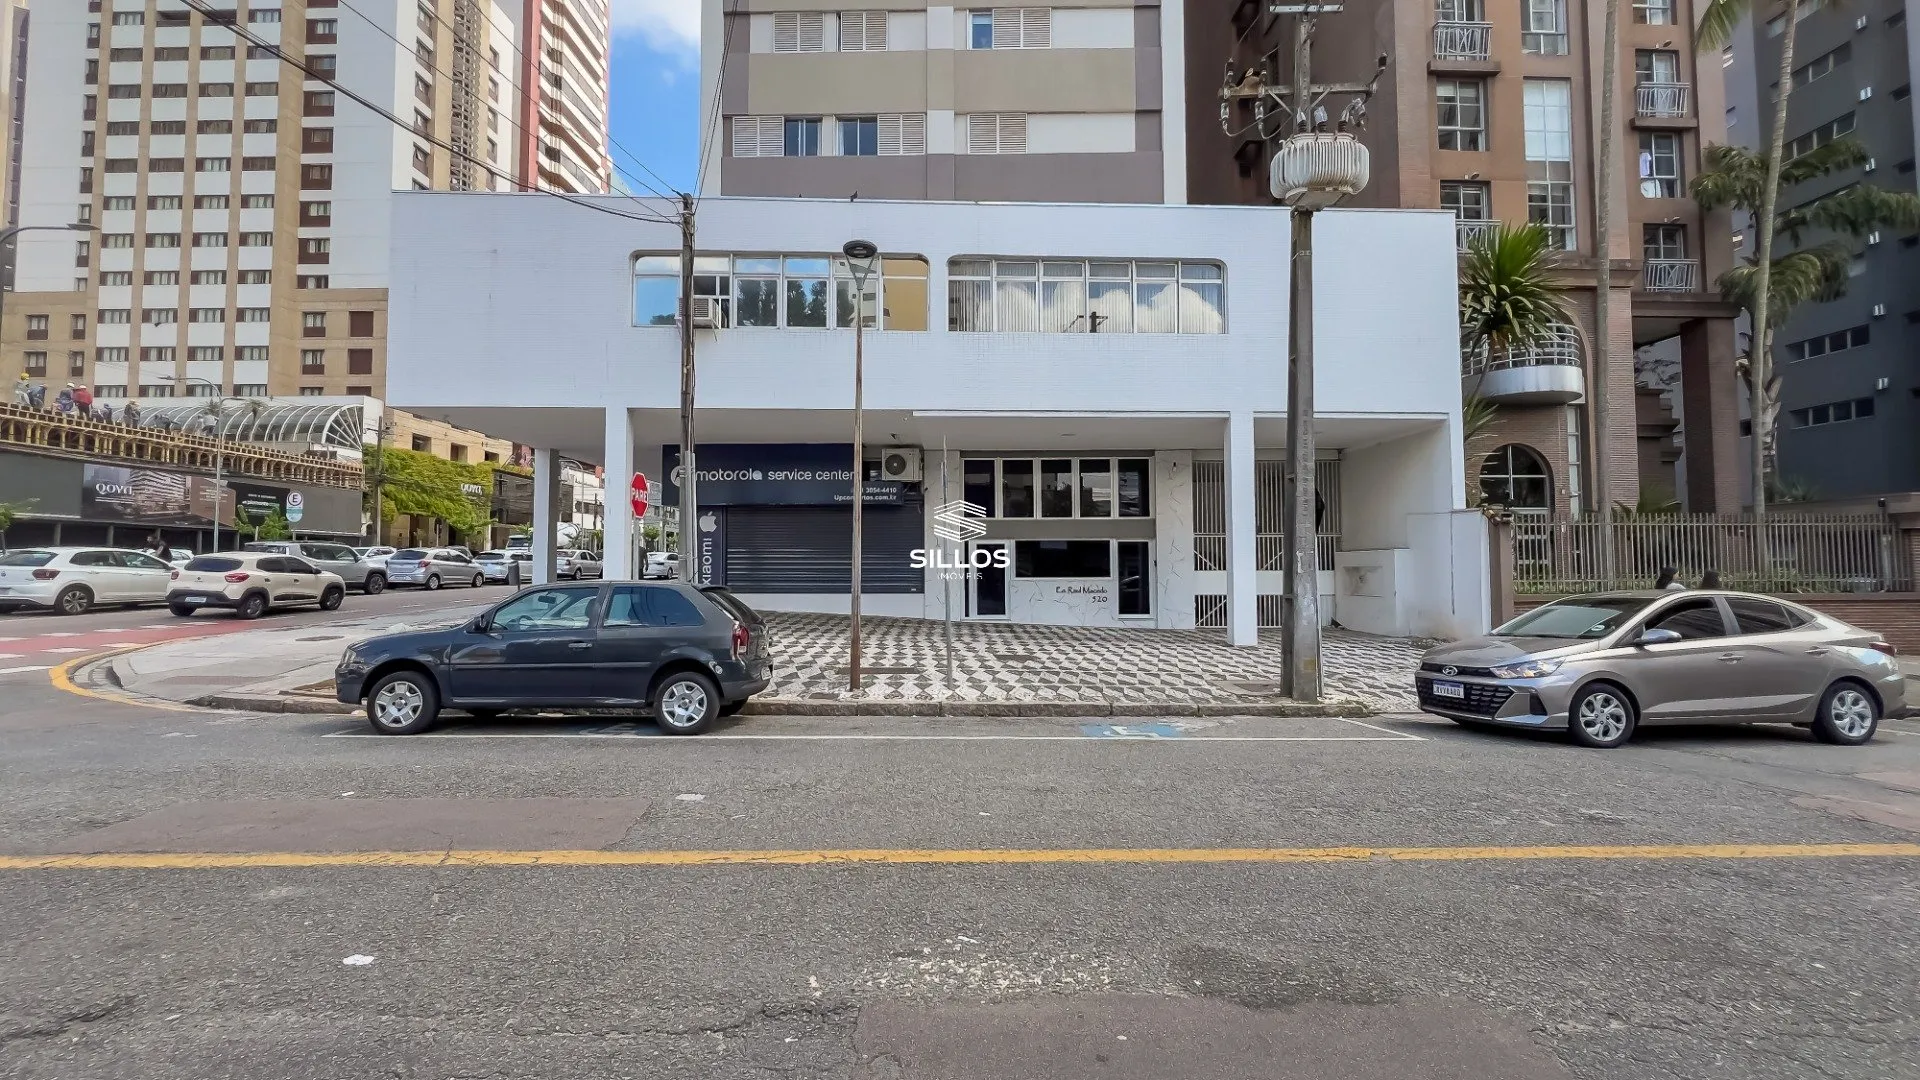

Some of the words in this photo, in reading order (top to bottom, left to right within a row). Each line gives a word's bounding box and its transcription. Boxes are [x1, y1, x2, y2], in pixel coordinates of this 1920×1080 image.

[696, 468, 762, 481] motorola
[768, 469, 812, 481] service
[815, 469, 855, 481] center
[292, 494, 298, 503] E
[632, 487, 648, 503] PARE
[702, 538, 712, 586] xiaomi
